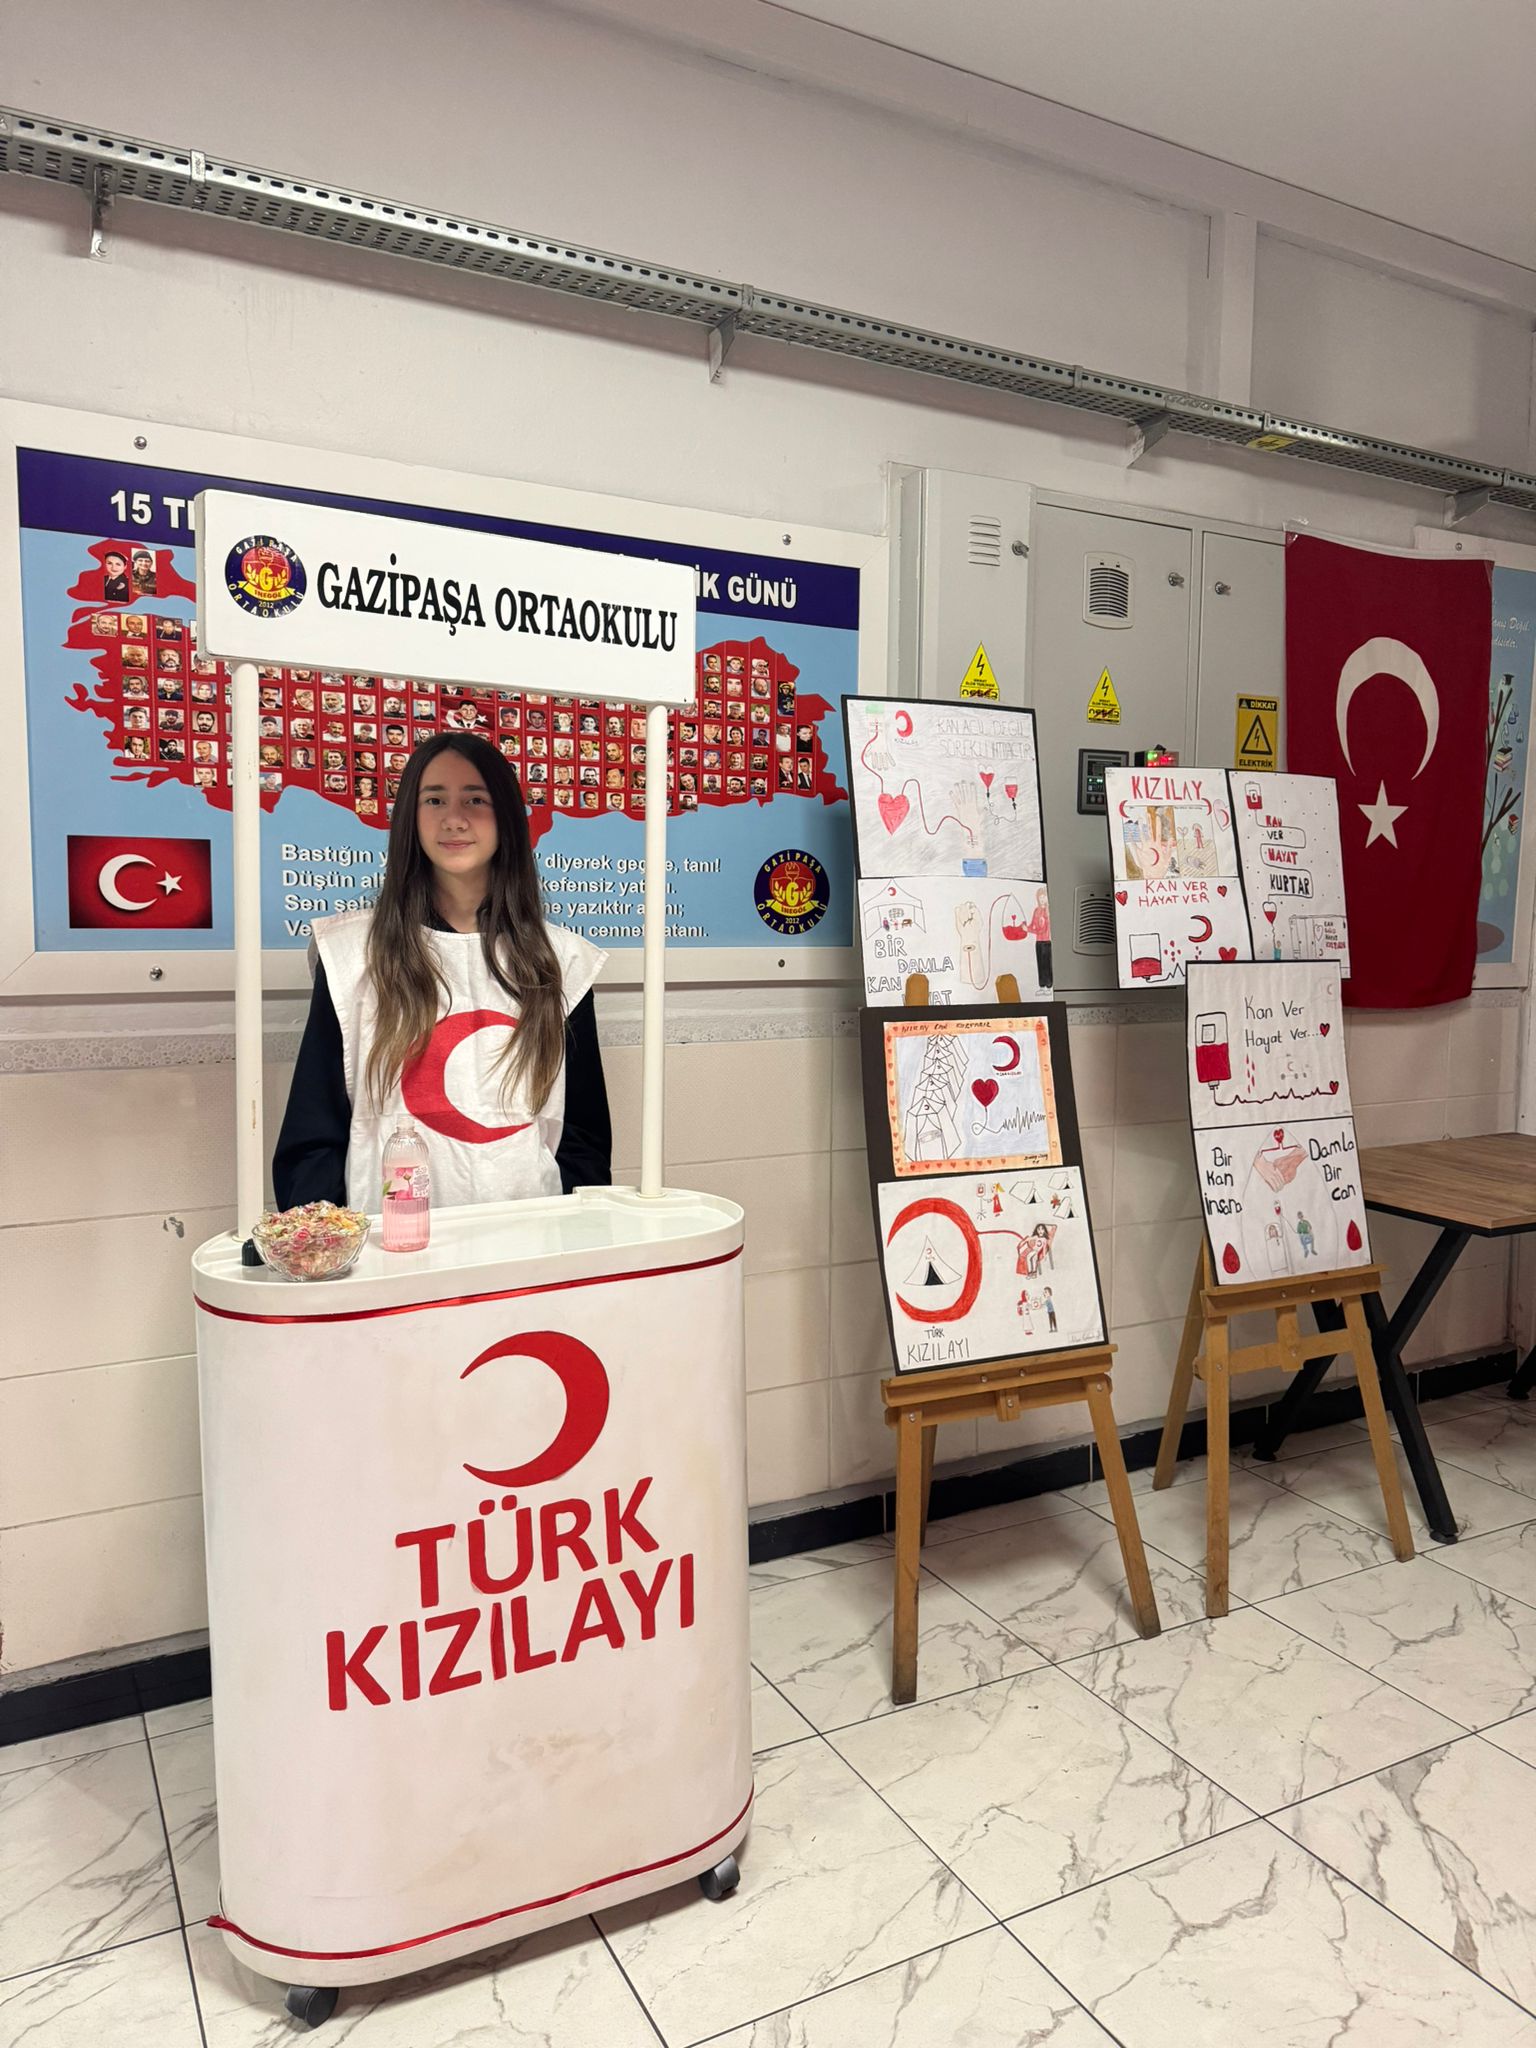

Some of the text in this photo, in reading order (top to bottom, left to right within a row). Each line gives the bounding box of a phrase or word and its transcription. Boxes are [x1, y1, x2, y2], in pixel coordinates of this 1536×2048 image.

[111, 490, 152, 525] 15
[695, 564, 797, 608] İK GÜNÜ
[317, 553, 678, 652] GAZİPAŞA ORTAOKULU
[1239, 758, 1273, 768] ELEKTRİK
[1131, 775, 1203, 801] KIZILAY
[1266, 830, 1284, 840] VER
[282, 843, 373, 866] Bastığın
[545, 853, 613, 872] diyerek
[684, 858, 721, 873] tanı!
[1267, 848, 1298, 865] HAYAT
[282, 869, 355, 891] Düşün
[540, 876, 616, 892] kefensiz
[1145, 880, 1209, 894] KAN VER
[1269, 873, 1310, 895] KURTAR
[284, 893, 328, 912] Sen
[1138, 892, 1210, 907] HAYAT VER
[757, 902, 828, 934] ORTAOKULU
[874, 934, 907, 958] BİR
[897, 956, 954, 974] DAMLA
[866, 976, 902, 994] KAN
[1244, 995, 1305, 1020] Kan Ver
[1245, 1029, 1282, 1054] Hayat
[1211, 1132, 1355, 1167] Bir Damla
[1322, 1164, 1343, 1182] Bir
[923, 1326, 946, 1339] TÜRK
[907, 1338, 970, 1365] KIZILAYI
[395, 1476, 659, 1608] TÜRK
[326, 1553, 694, 1711] KIZILAYI
